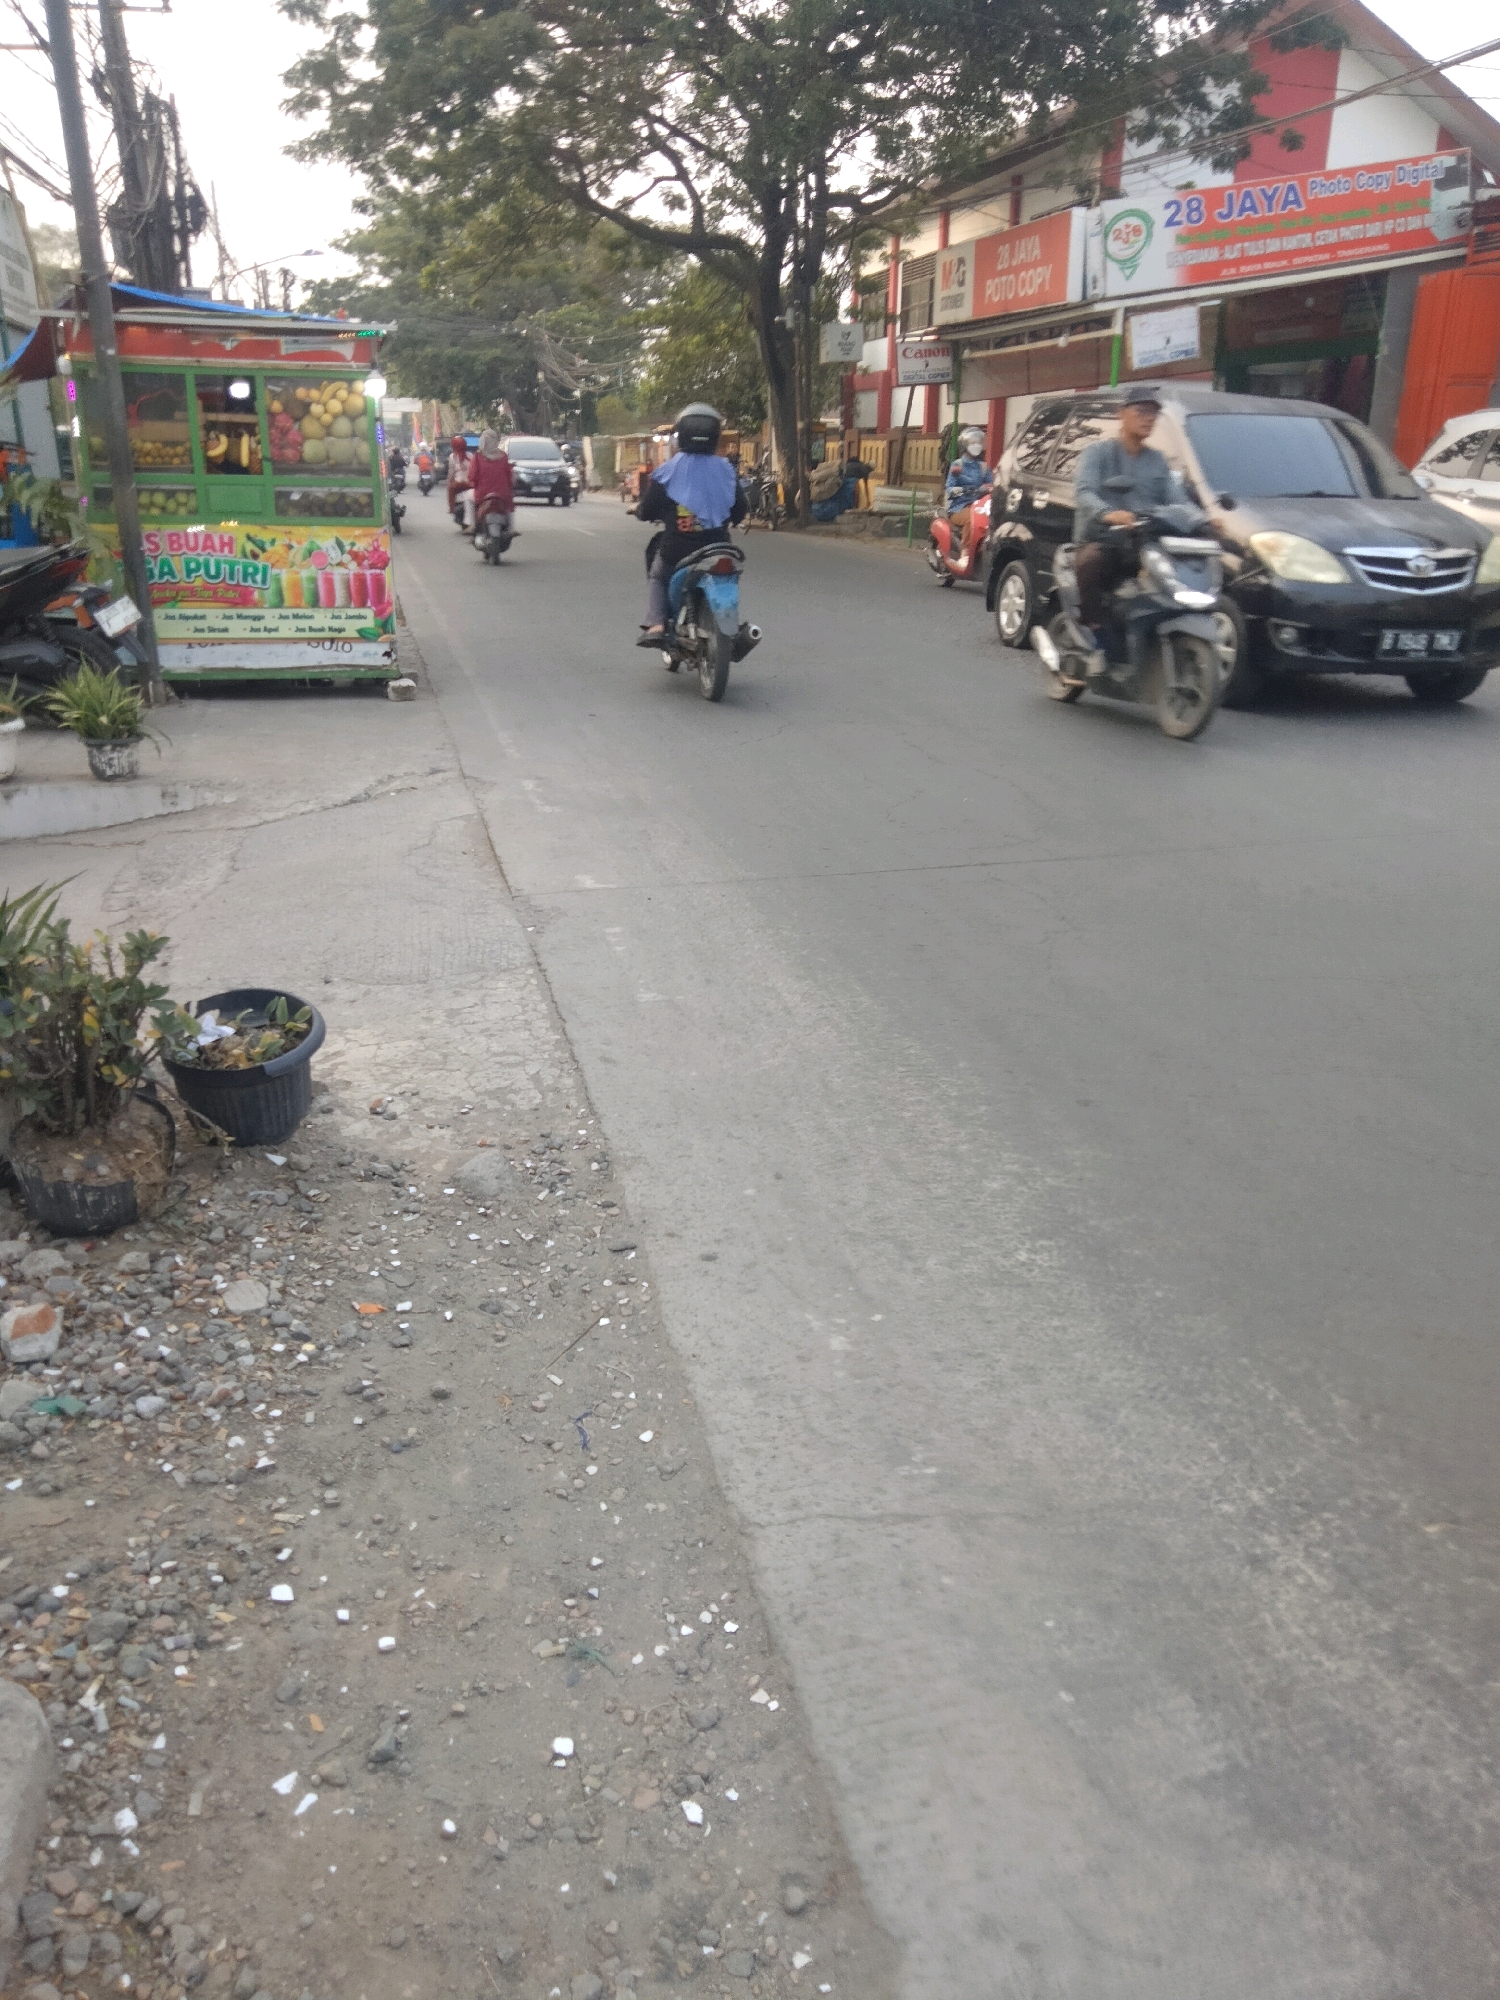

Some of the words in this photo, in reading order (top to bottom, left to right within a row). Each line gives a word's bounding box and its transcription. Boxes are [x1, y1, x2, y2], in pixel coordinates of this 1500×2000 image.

[1164, 196, 1205, 227] 28
[1215, 182, 1305, 221] JAYA
[1308, 175, 1351, 198] Photo
[1356, 170, 1393, 192] Copy
[1396, 161, 1445, 187] Digital
[1018, 264, 1053, 298] COPY
[902, 346, 951, 359] Canon
[165, 530, 237, 556] BUAH
[182, 555, 271, 589] PUTRI
